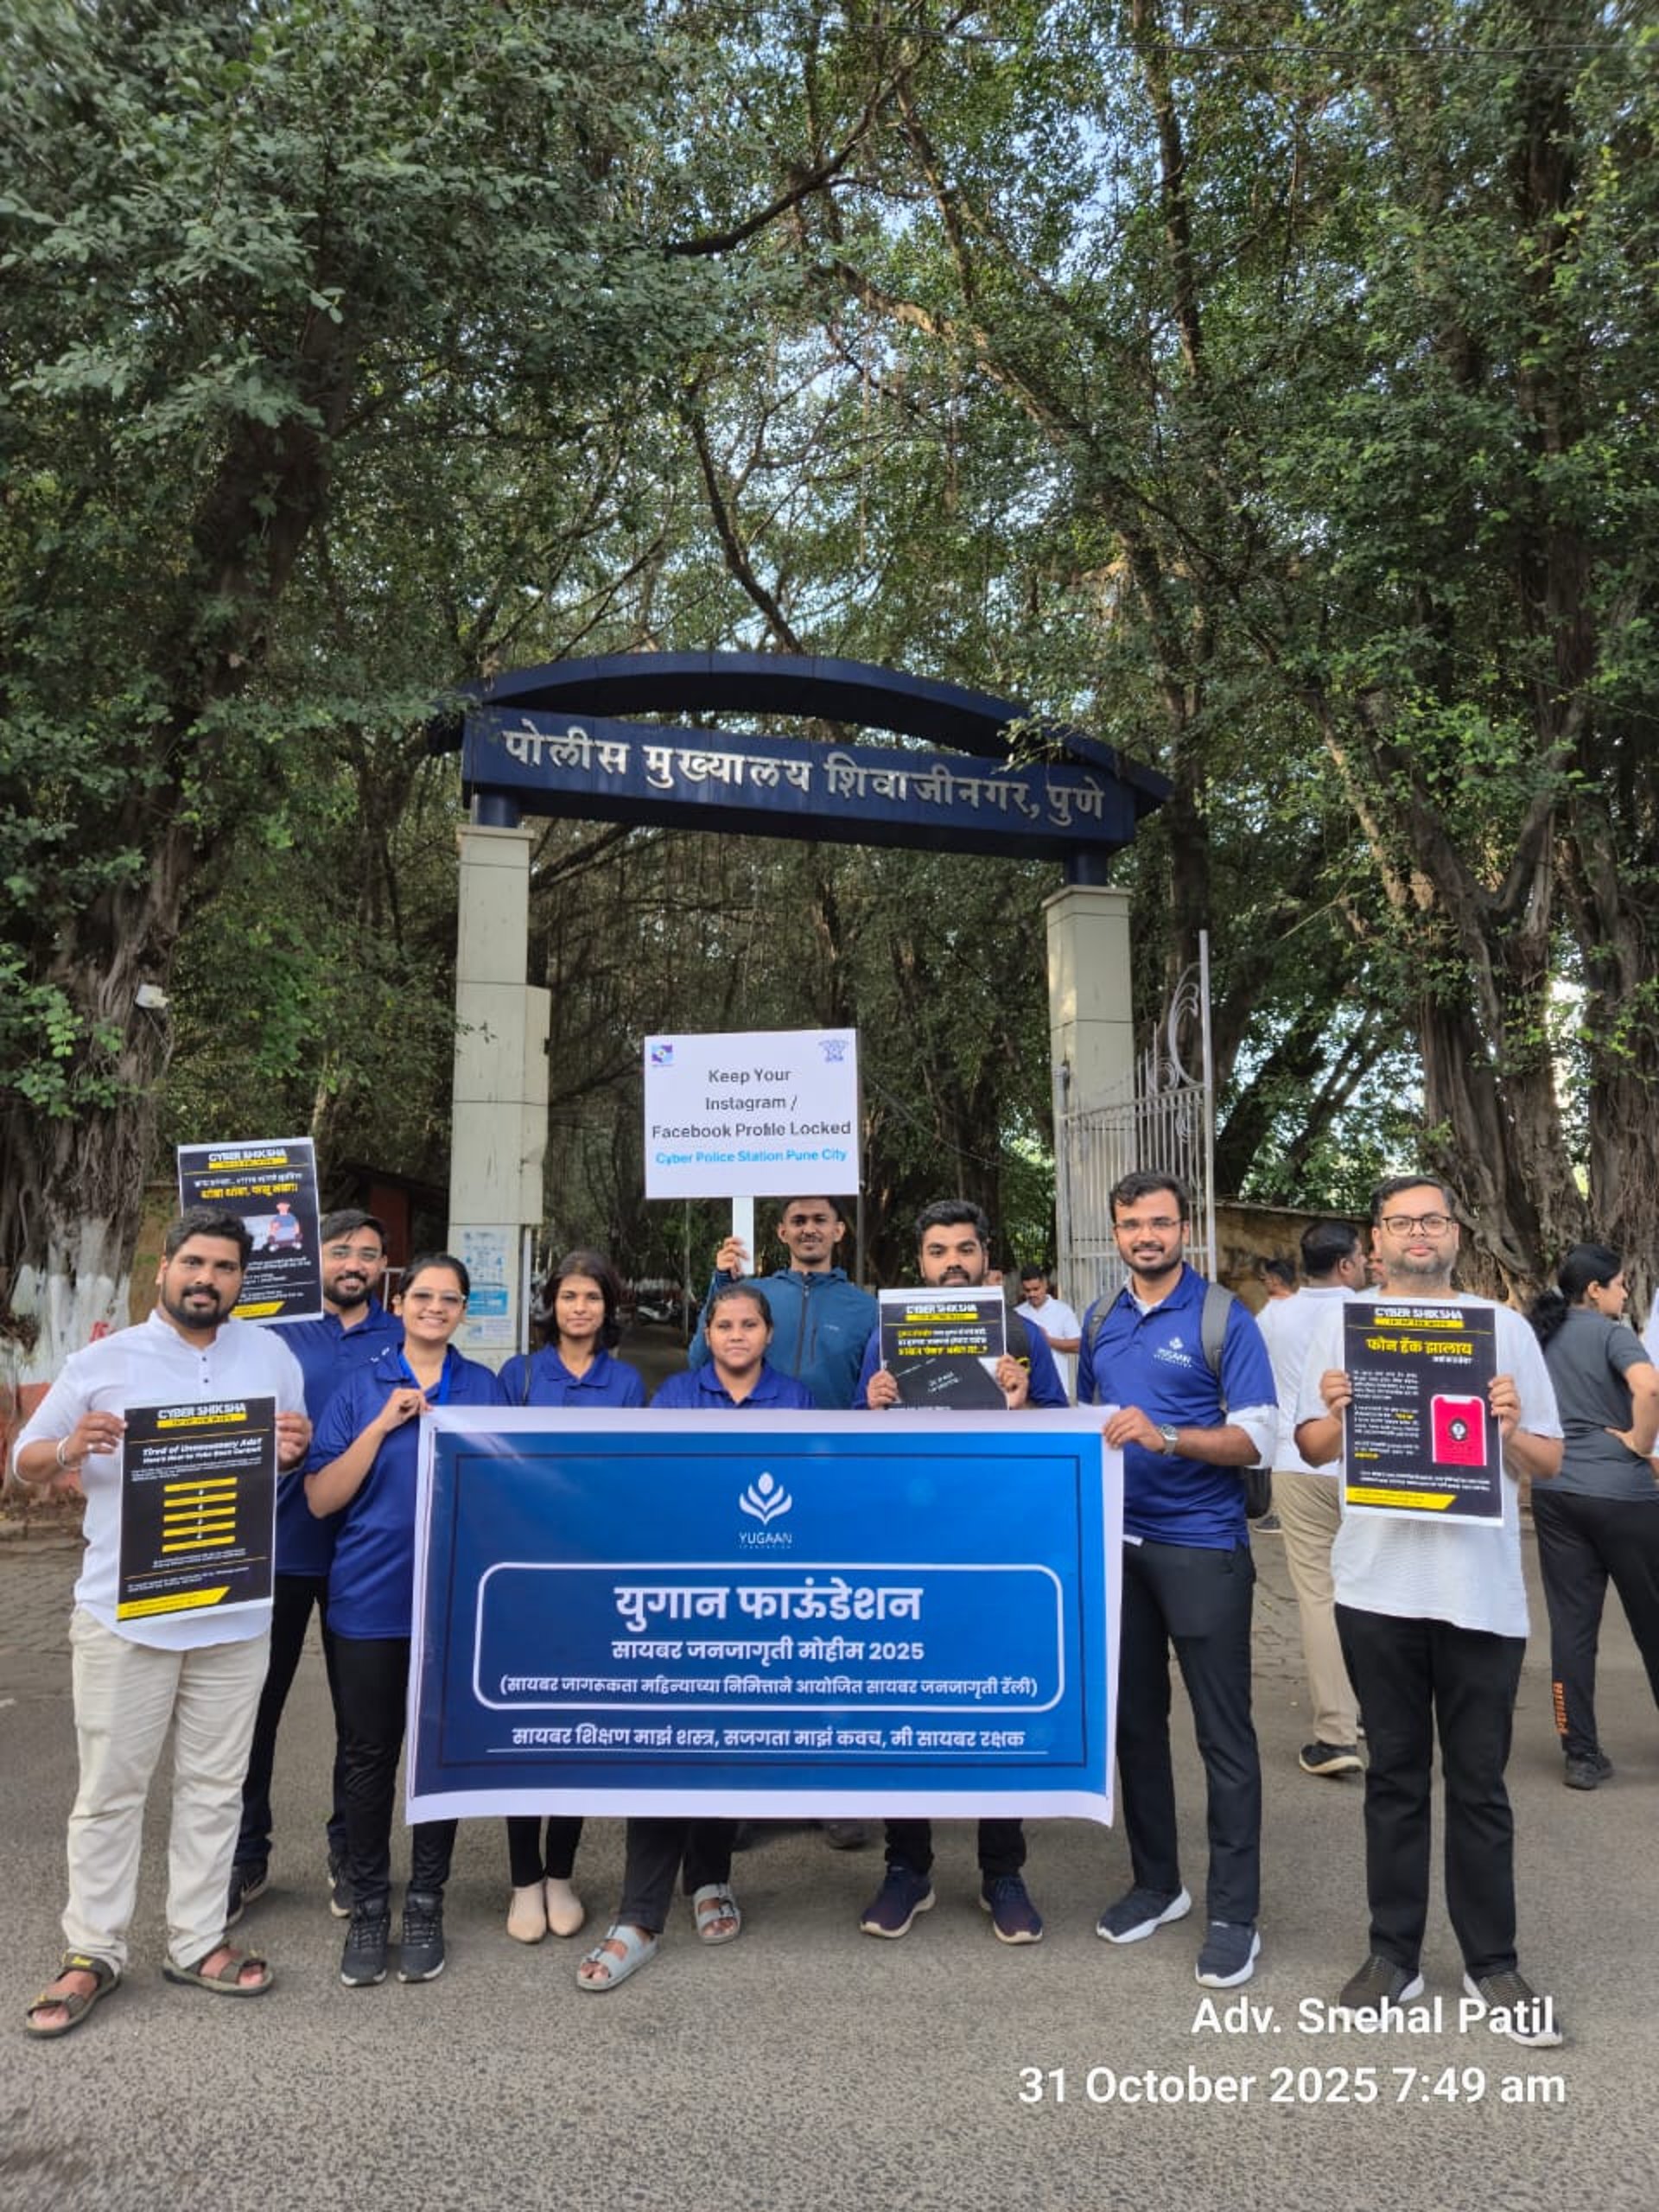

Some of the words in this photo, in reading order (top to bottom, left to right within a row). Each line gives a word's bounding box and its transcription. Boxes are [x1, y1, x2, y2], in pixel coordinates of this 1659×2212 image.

[503, 718, 632, 772] पोलीस
[644, 744, 814, 790] मुख्यालय
[823, 751, 1042, 820] शिवाजीनगर,
[1046, 773, 1105, 826] पुणे
[709, 1069, 750, 1087] Keep
[754, 1068, 791, 1084] Your
[706, 1096, 785, 1112] Instagram
[652, 1124, 732, 1139] Facebook
[736, 1122, 786, 1136] Profile
[790, 1120, 851, 1135] Locked
[655, 1151, 693, 1166] Cyber
[696, 1150, 735, 1162] Police
[738, 1149, 784, 1161] Station
[786, 1147, 819, 1160] Pune
[822, 1146, 848, 1161] City
[1374, 1307, 1411, 1318] CYBER
[1413, 1308, 1464, 1319] SHIKSHA
[157, 1408, 195, 1420] CYBER
[196, 1402, 246, 1415] SHIKSHA
[739, 1531, 792, 1544] YUGAAN
[614, 1586, 730, 1632] युगान
[737, 1577, 924, 1620] फाऊंडेशन
[612, 1642, 683, 1661] सायबर
[688, 1635, 794, 1668] जनजागृती
[798, 1637, 865, 1663] मोहीम
[868, 1643, 925, 1661] 2025
[500, 1675, 558, 1695] (सायबर
[796, 1675, 862, 1695] आयोजित
[867, 1679, 916, 1695] सायबर
[920, 1676, 997, 1700] जनजागृती
[512, 1728, 571, 1746] सायबर
[575, 1723, 632, 1746] शिक्षण
[633, 1725, 672, 1747] माझं
[723, 1728, 791, 1746] सजगता
[794, 1726, 832, 1746] माझं
[836, 1728, 887, 1748] कवच,
[891, 1725, 913, 1746] मी
[916, 1728, 975, 1747] सायबर
[980, 1730, 1025, 1748] रक्षक
